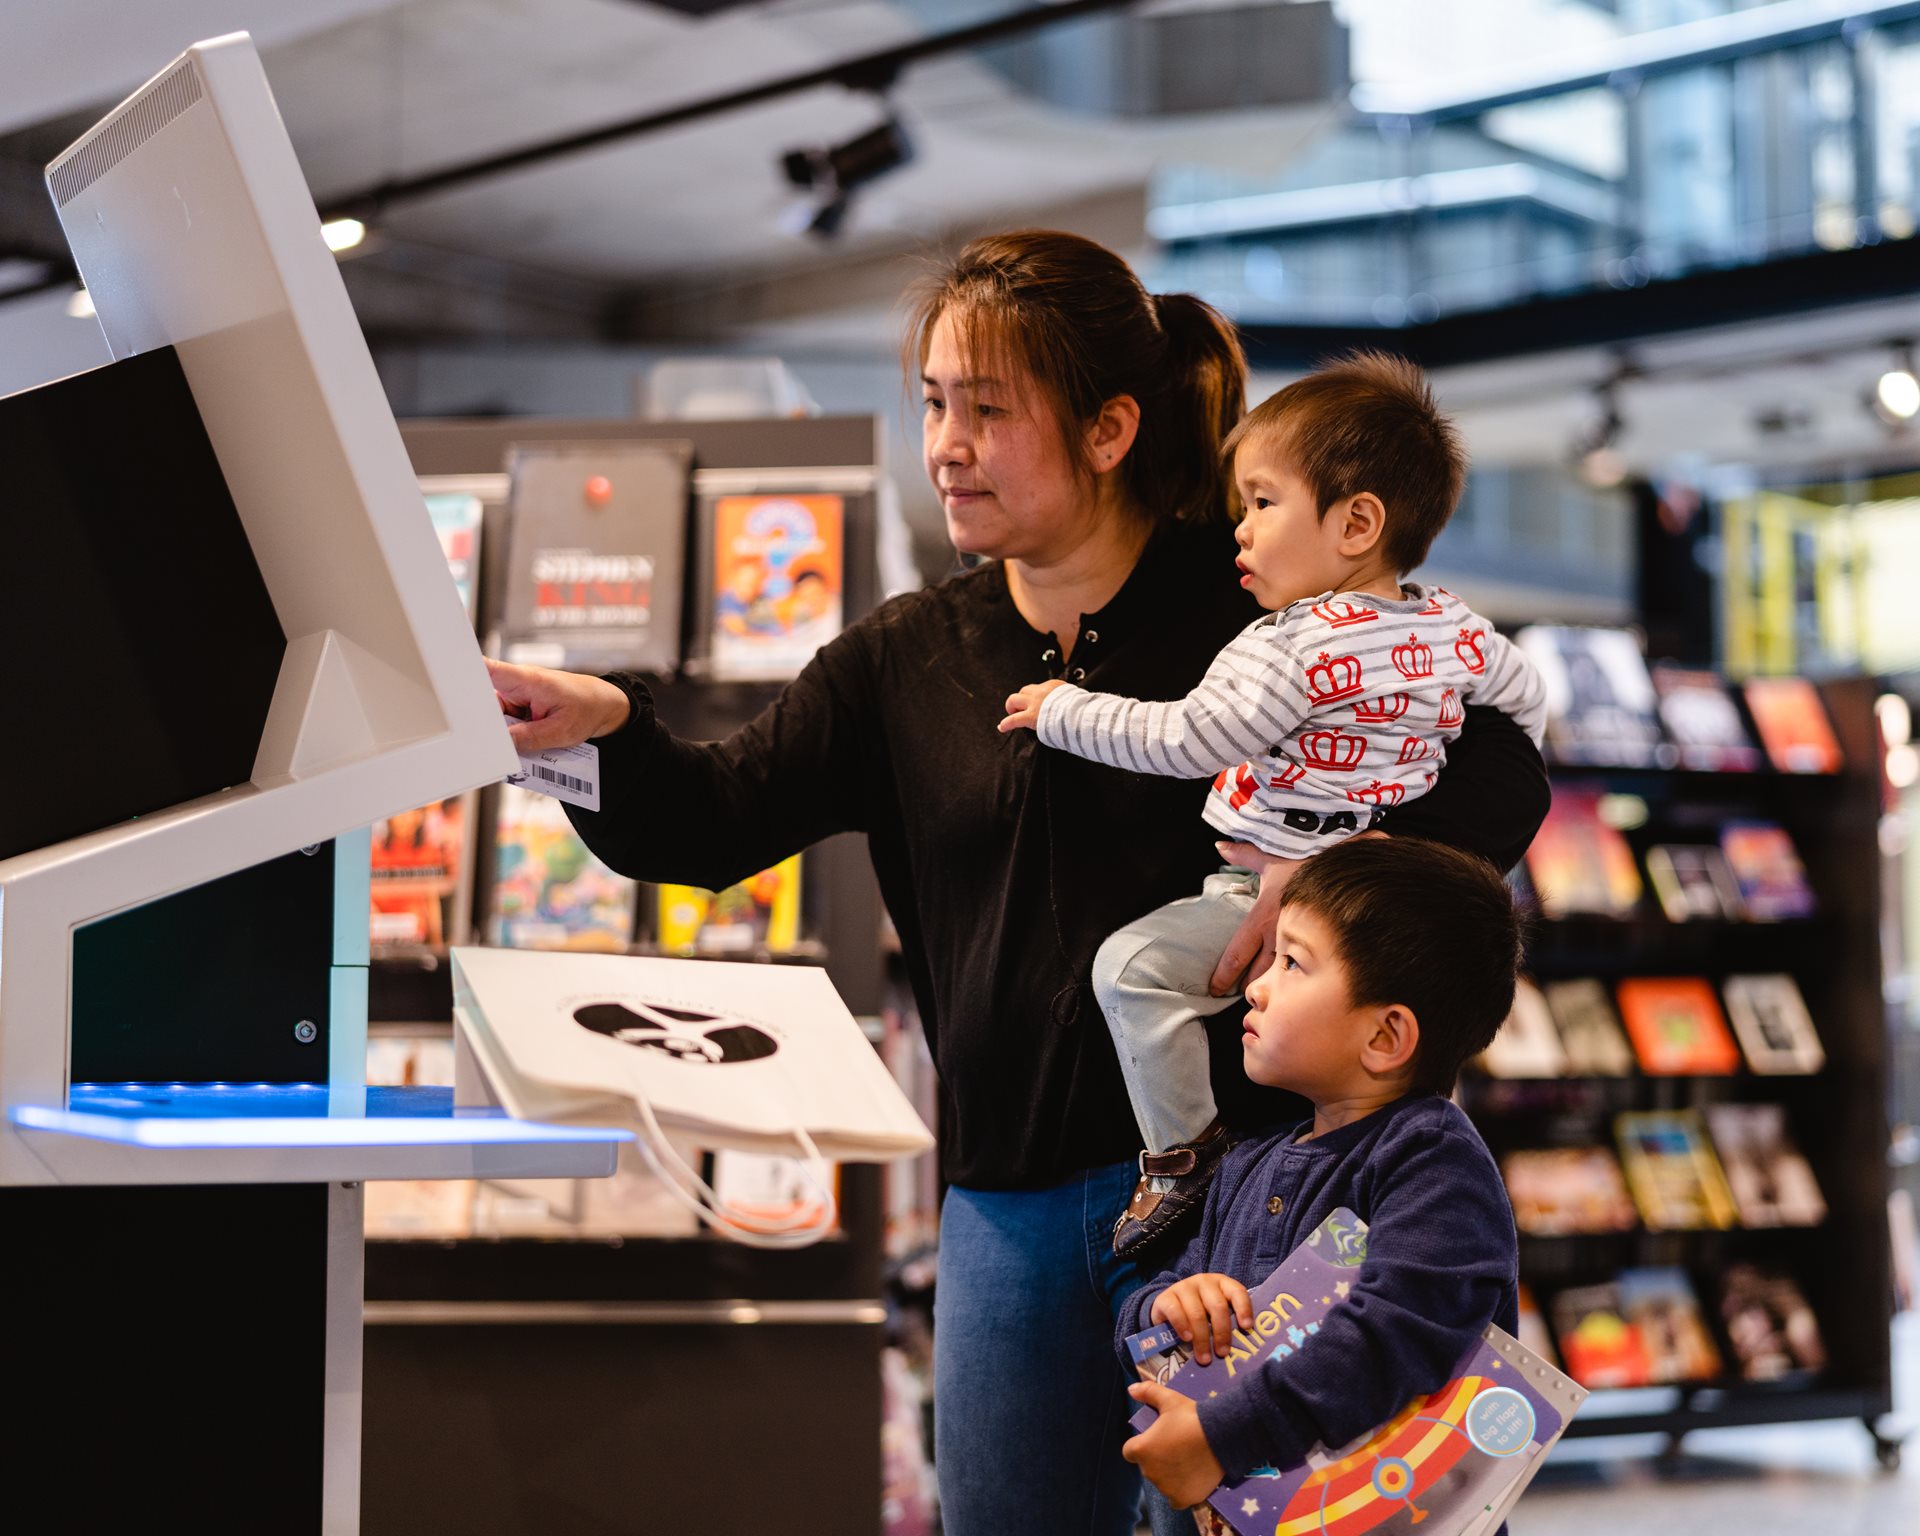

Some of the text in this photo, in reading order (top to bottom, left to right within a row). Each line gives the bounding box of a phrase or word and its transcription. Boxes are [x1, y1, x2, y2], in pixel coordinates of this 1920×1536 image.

[536, 580, 650, 607] KING
[1480, 1401, 1500, 1420] with
[1480, 1402, 1519, 1442] big flaps
[1497, 1434, 1509, 1445] to
